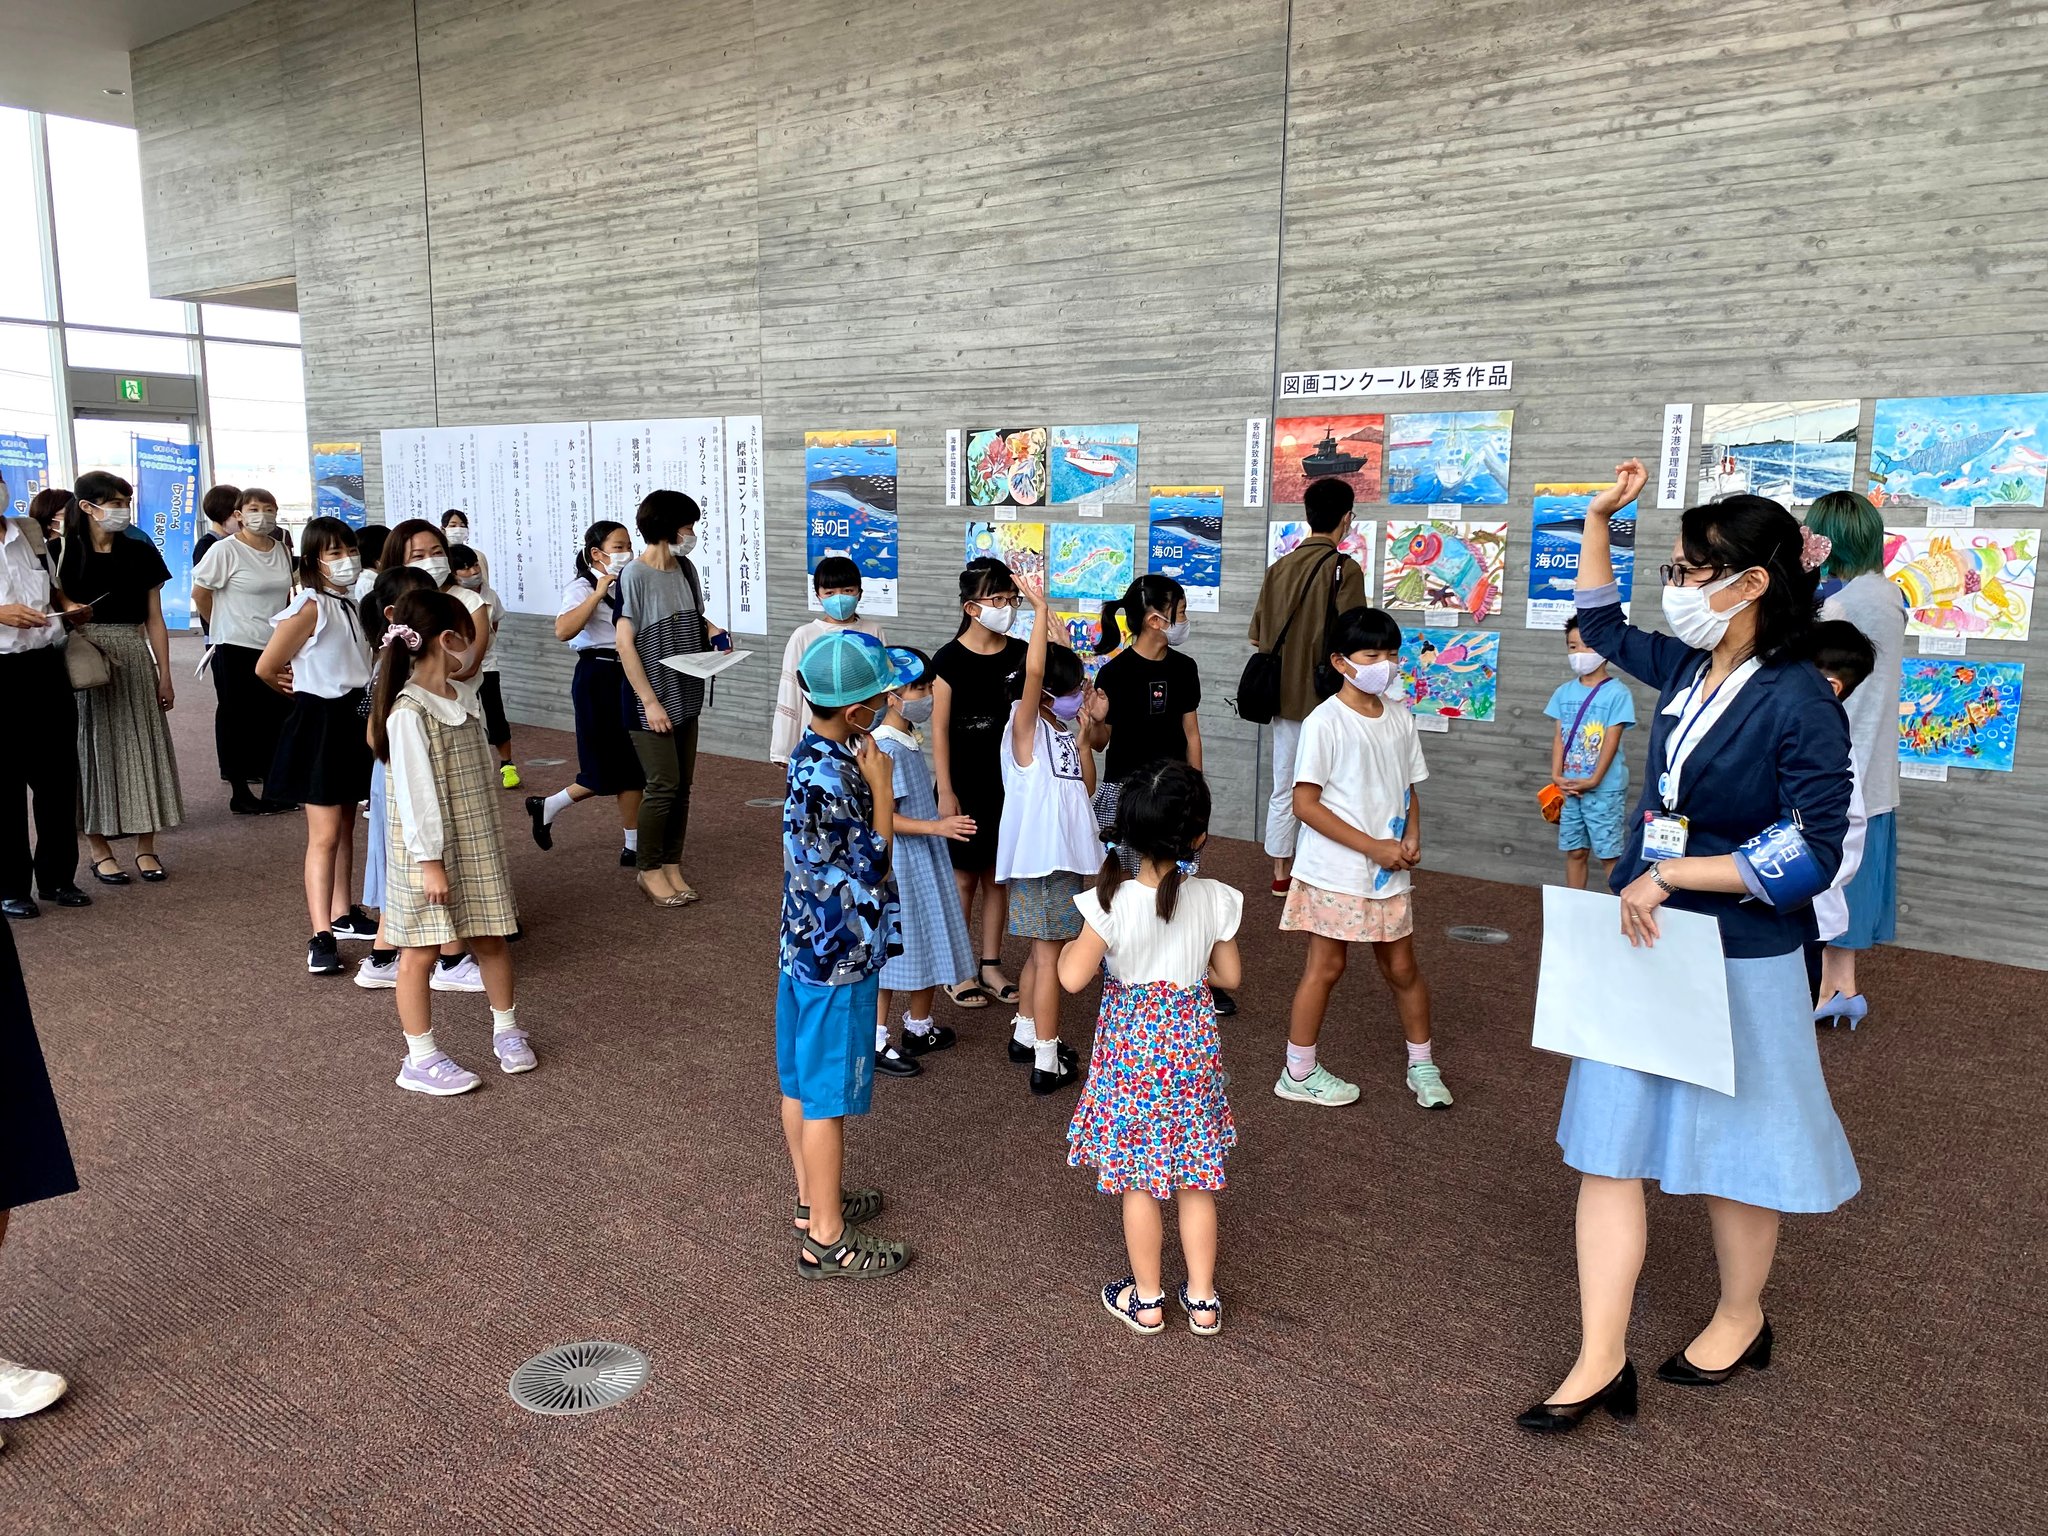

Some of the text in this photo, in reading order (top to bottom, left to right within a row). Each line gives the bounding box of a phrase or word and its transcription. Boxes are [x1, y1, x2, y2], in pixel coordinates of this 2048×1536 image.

[1283, 365, 1509, 396] 図画コンクール優秀作品
[568, 440, 575, 451] 水
[1666, 414, 1683, 500] 清水港管理局長賞
[569, 458, 577, 492] ひかり
[1250, 421, 1261, 504] 客船誘致委員会長賞
[698, 436, 710, 602] 守ろうよ 命をつなぐ 川と海
[737, 440, 751, 613] 標語コンクール入賞作品
[811, 519, 849, 538] 海の日
[1152, 545, 1183, 559] 海の日
[1535, 553, 1579, 569] 海の日
